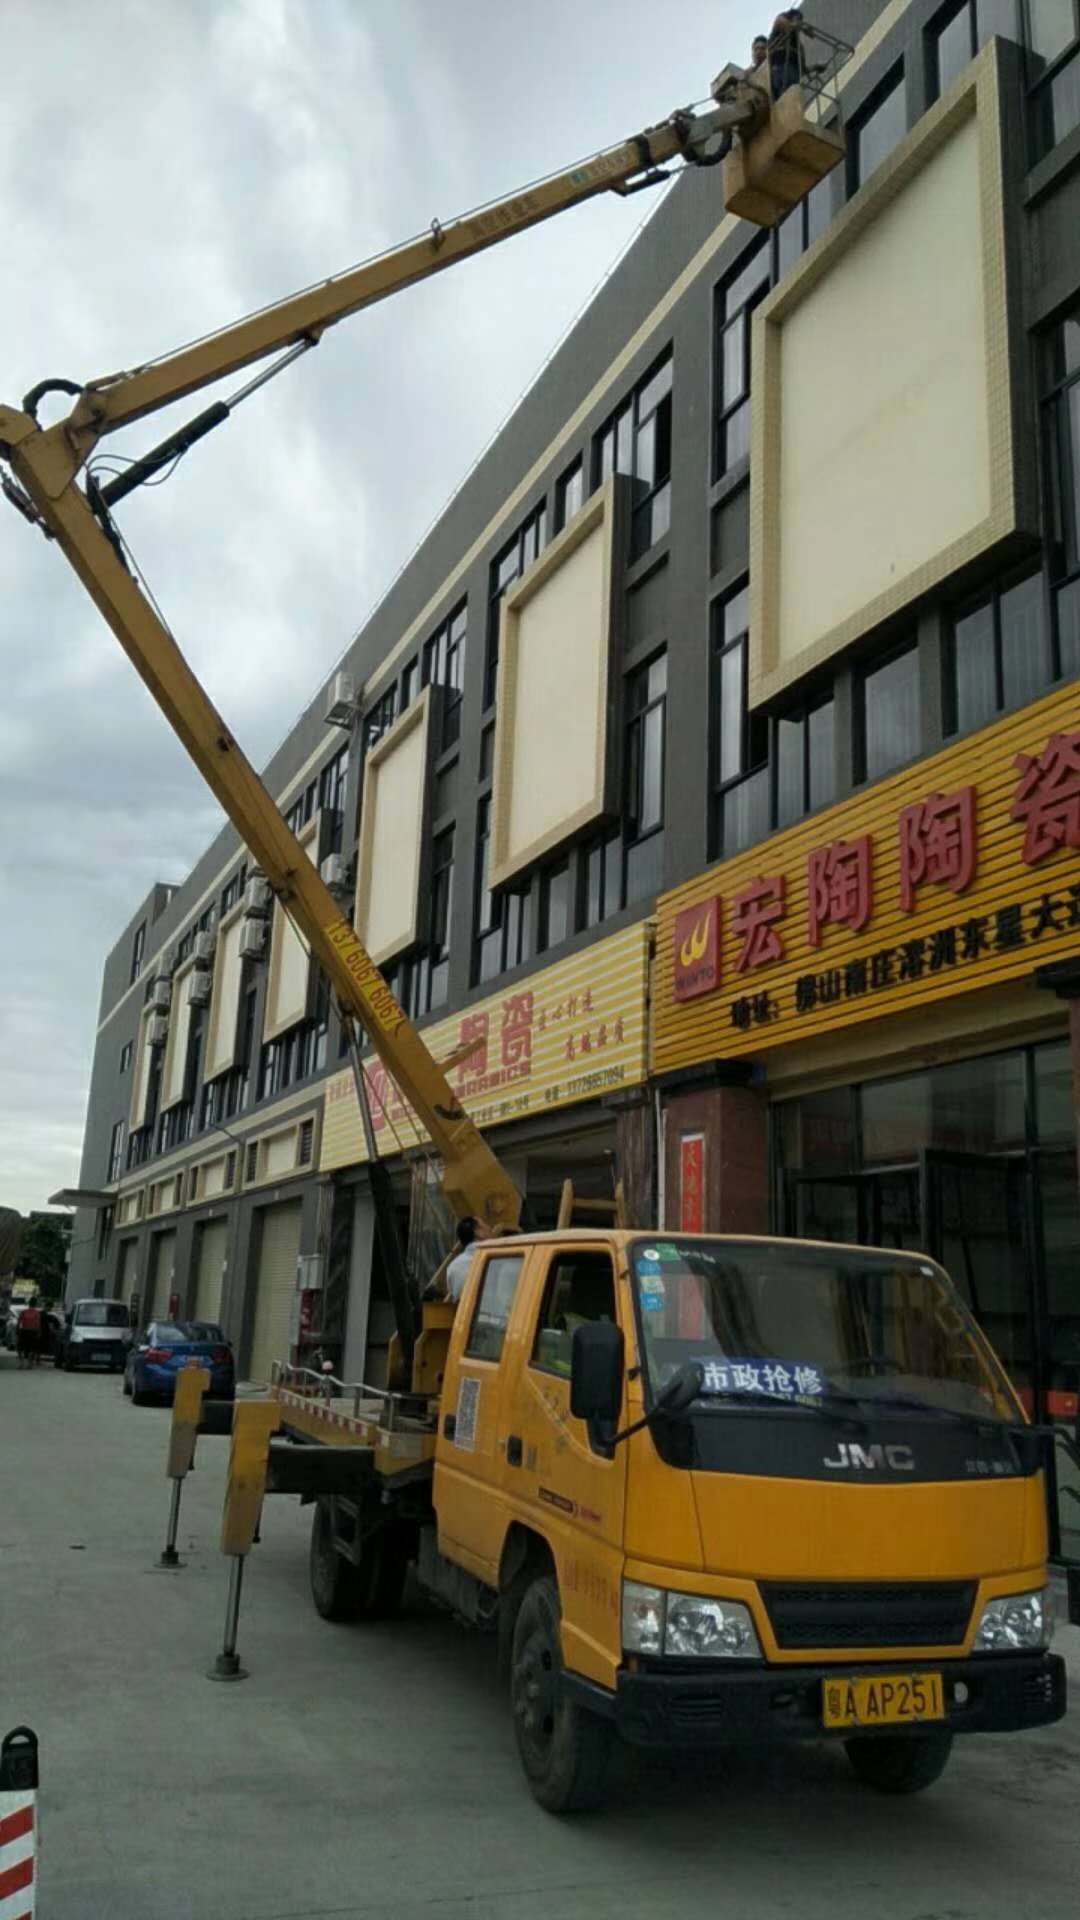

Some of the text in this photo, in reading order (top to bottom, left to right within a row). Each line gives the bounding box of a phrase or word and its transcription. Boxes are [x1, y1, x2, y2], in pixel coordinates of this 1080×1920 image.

[346, 949, 381, 987] 6067
[369, 986, 406, 1026] 6067
[704, 1362, 823, 1394] 市政抢修
[823, 1443, 915, 1470] JMC
[866, 1680, 939, 1717] AP251
